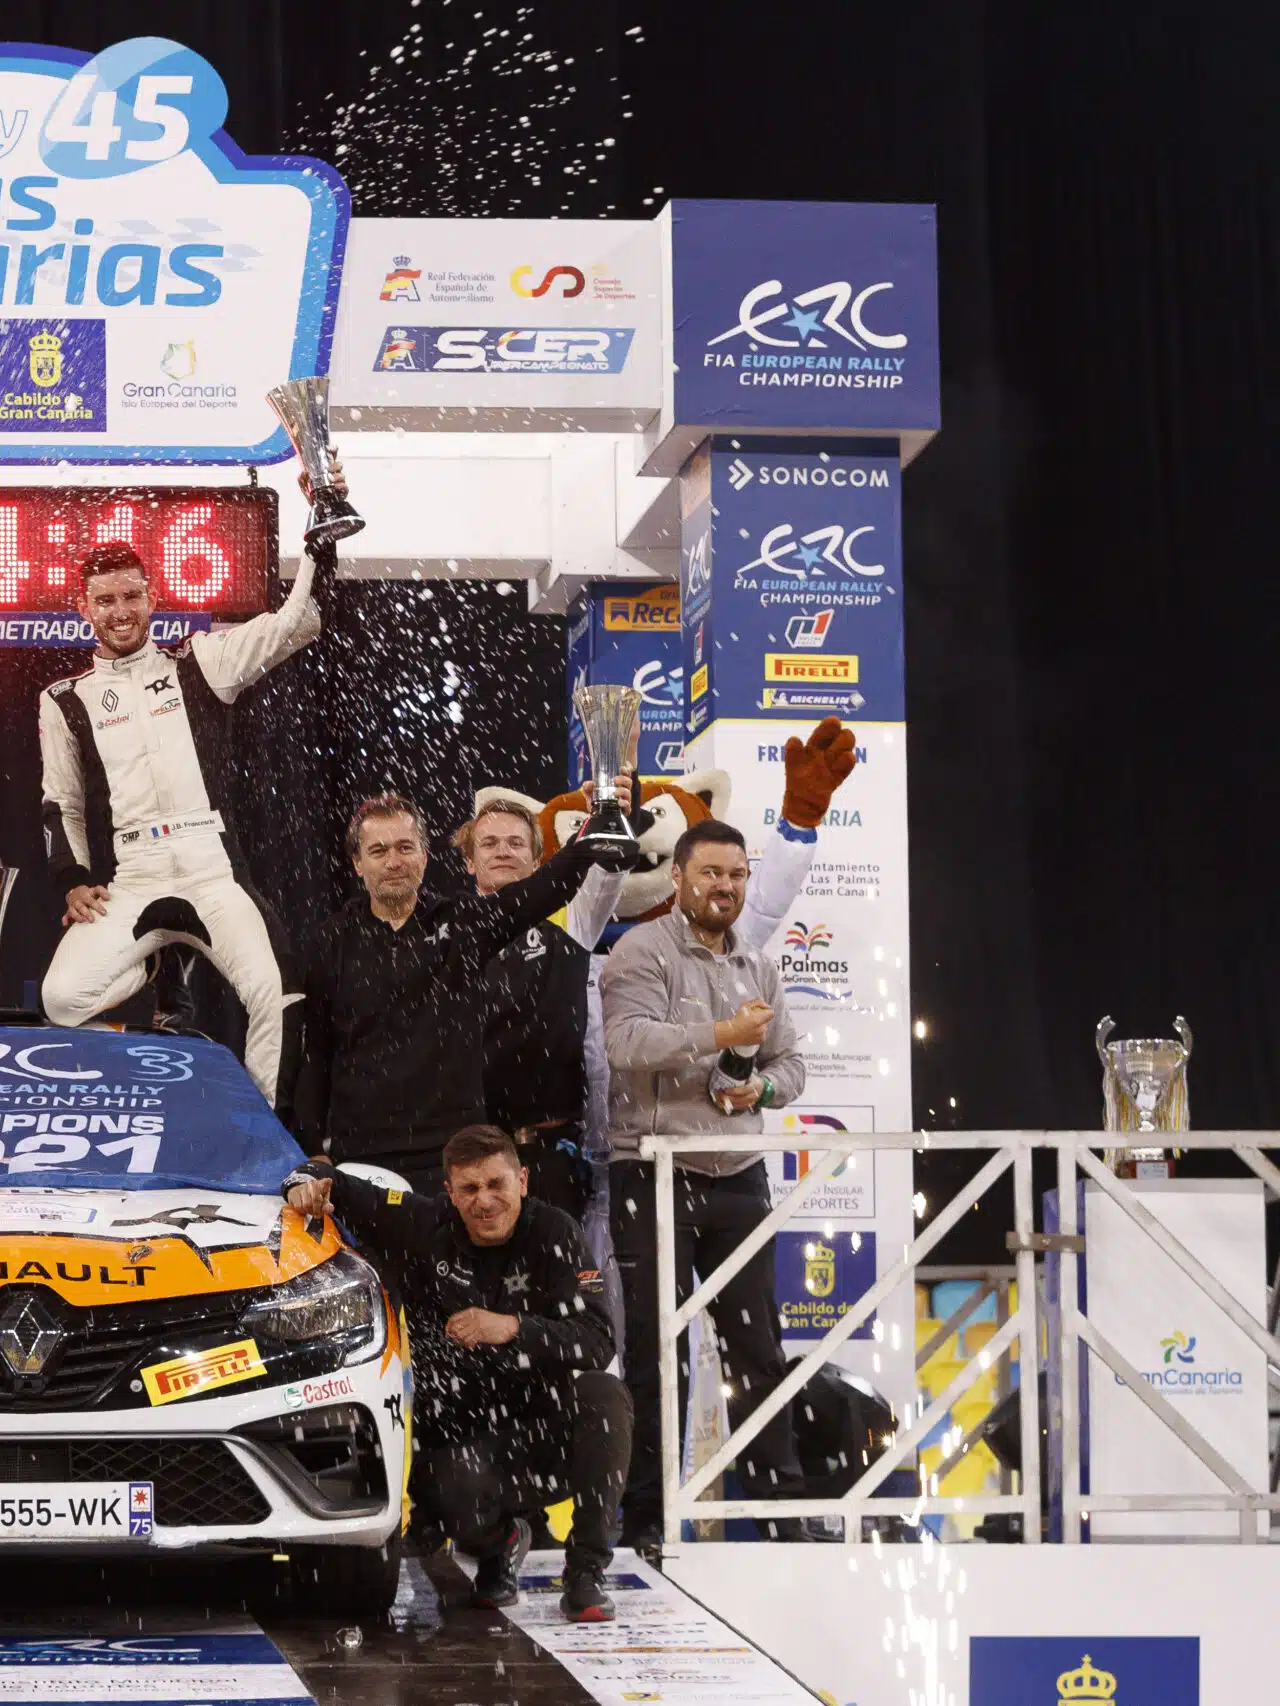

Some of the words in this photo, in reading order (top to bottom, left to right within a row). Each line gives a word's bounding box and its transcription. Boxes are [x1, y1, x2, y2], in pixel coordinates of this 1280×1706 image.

[44, 75, 193, 160] 45
[704, 354, 735, 367] FIA
[741, 355, 842, 369] EUROPEAN
[848, 357, 906, 371] RALLY
[740, 372, 903, 389] CHAMPIONSHIP
[123, 382, 165, 397] Gran
[168, 382, 236, 397] Canaria
[4, 393, 61, 405] Cabildo
[140, 400, 179, 410] Europea
[182, 400, 197, 408] del
[201, 400, 238, 410] Deporte
[37, 407, 93, 419] Canaria
[759, 467, 889, 487] SONOCOM
[734, 579, 757, 589] FIA
[762, 580, 836, 591] EUROPEAN
[840, 582, 883, 592] RALLY
[761, 593, 881, 605] CHAMPIONSHIP
[775, 660, 849, 676] PIRELLI
[790, 695, 849, 704] MICHELIN
[642, 710, 683, 719] UROPE
[122, 831, 140, 844] OMP
[811, 874, 830, 884] Las
[837, 874, 880, 884] Palmas
[806, 886, 833, 896] Gran
[127, 1046, 194, 1082] 3
[70, 1084, 166, 1096] RALLY
[800, 1198, 859, 1209] EPORTES
[781, 1302, 834, 1314] Cabildo
[155, 1349, 250, 1394] PIRELLI
[303, 1376, 354, 1403] Castrol
[131, 1518, 152, 1534] 75
